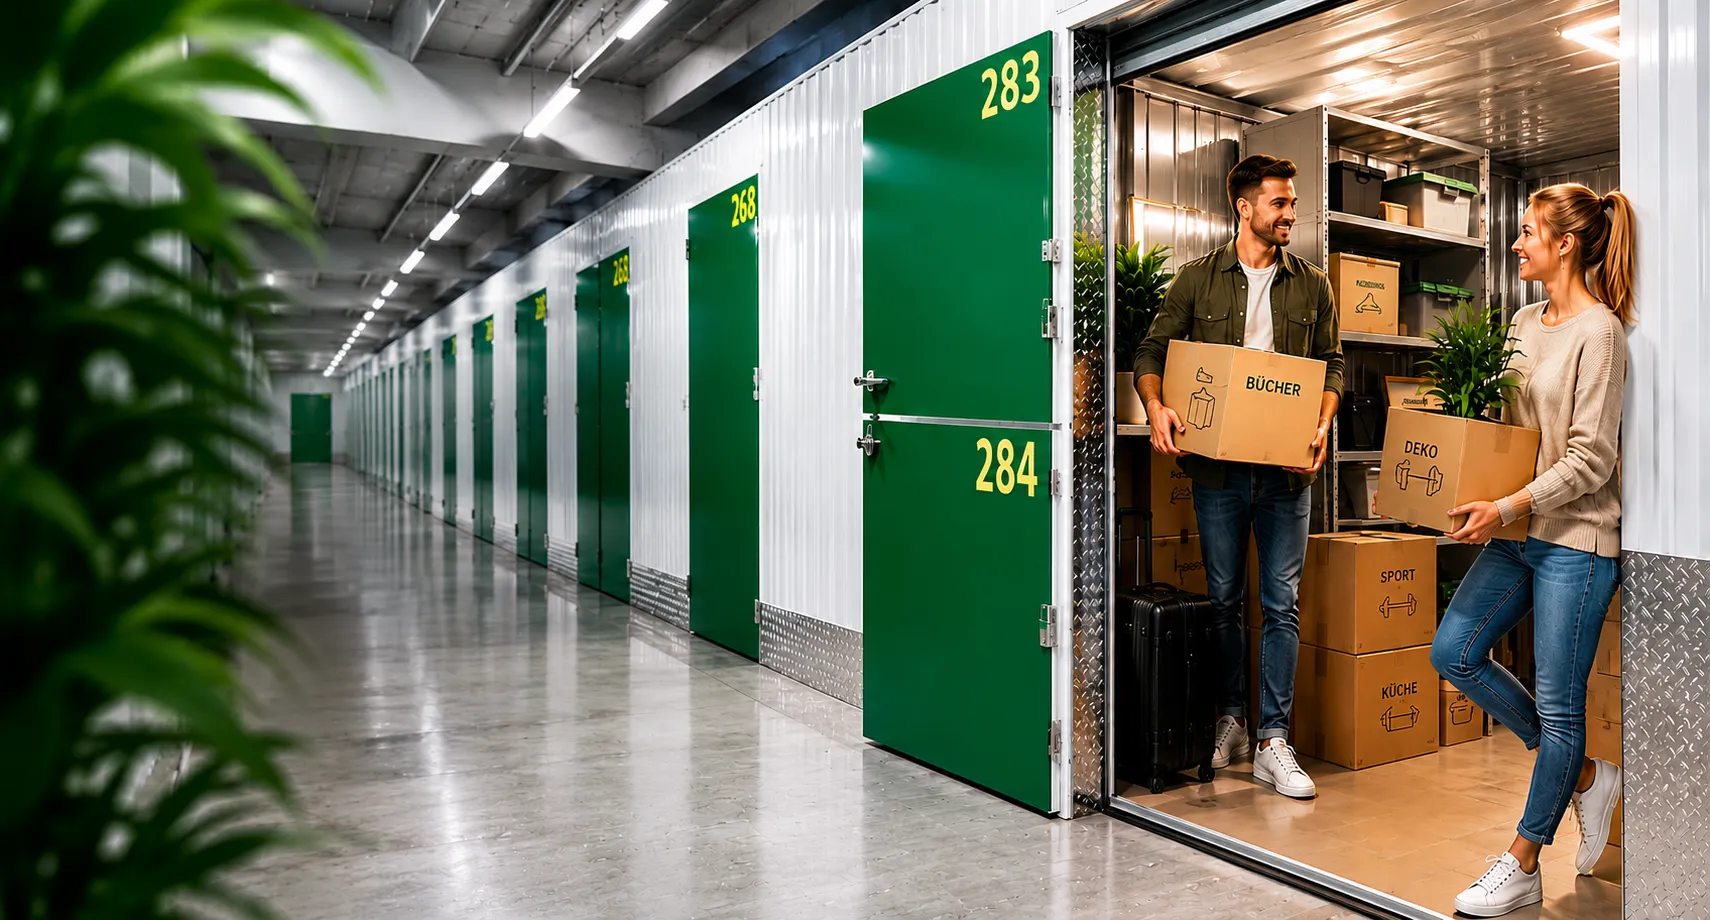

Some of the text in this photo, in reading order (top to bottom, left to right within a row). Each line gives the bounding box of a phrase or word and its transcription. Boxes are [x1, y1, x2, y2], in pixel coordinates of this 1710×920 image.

[981, 50, 1040, 120] 283
[731, 185, 756, 228] 268
[613, 255, 629, 286] 268
[1246, 375, 1301, 397] BÜCHER
[1404, 440, 1438, 459] DEKO
[976, 437, 1038, 497] 284
[1380, 569, 1416, 583] SPORT
[1381, 682, 1418, 699] KÜCHE
